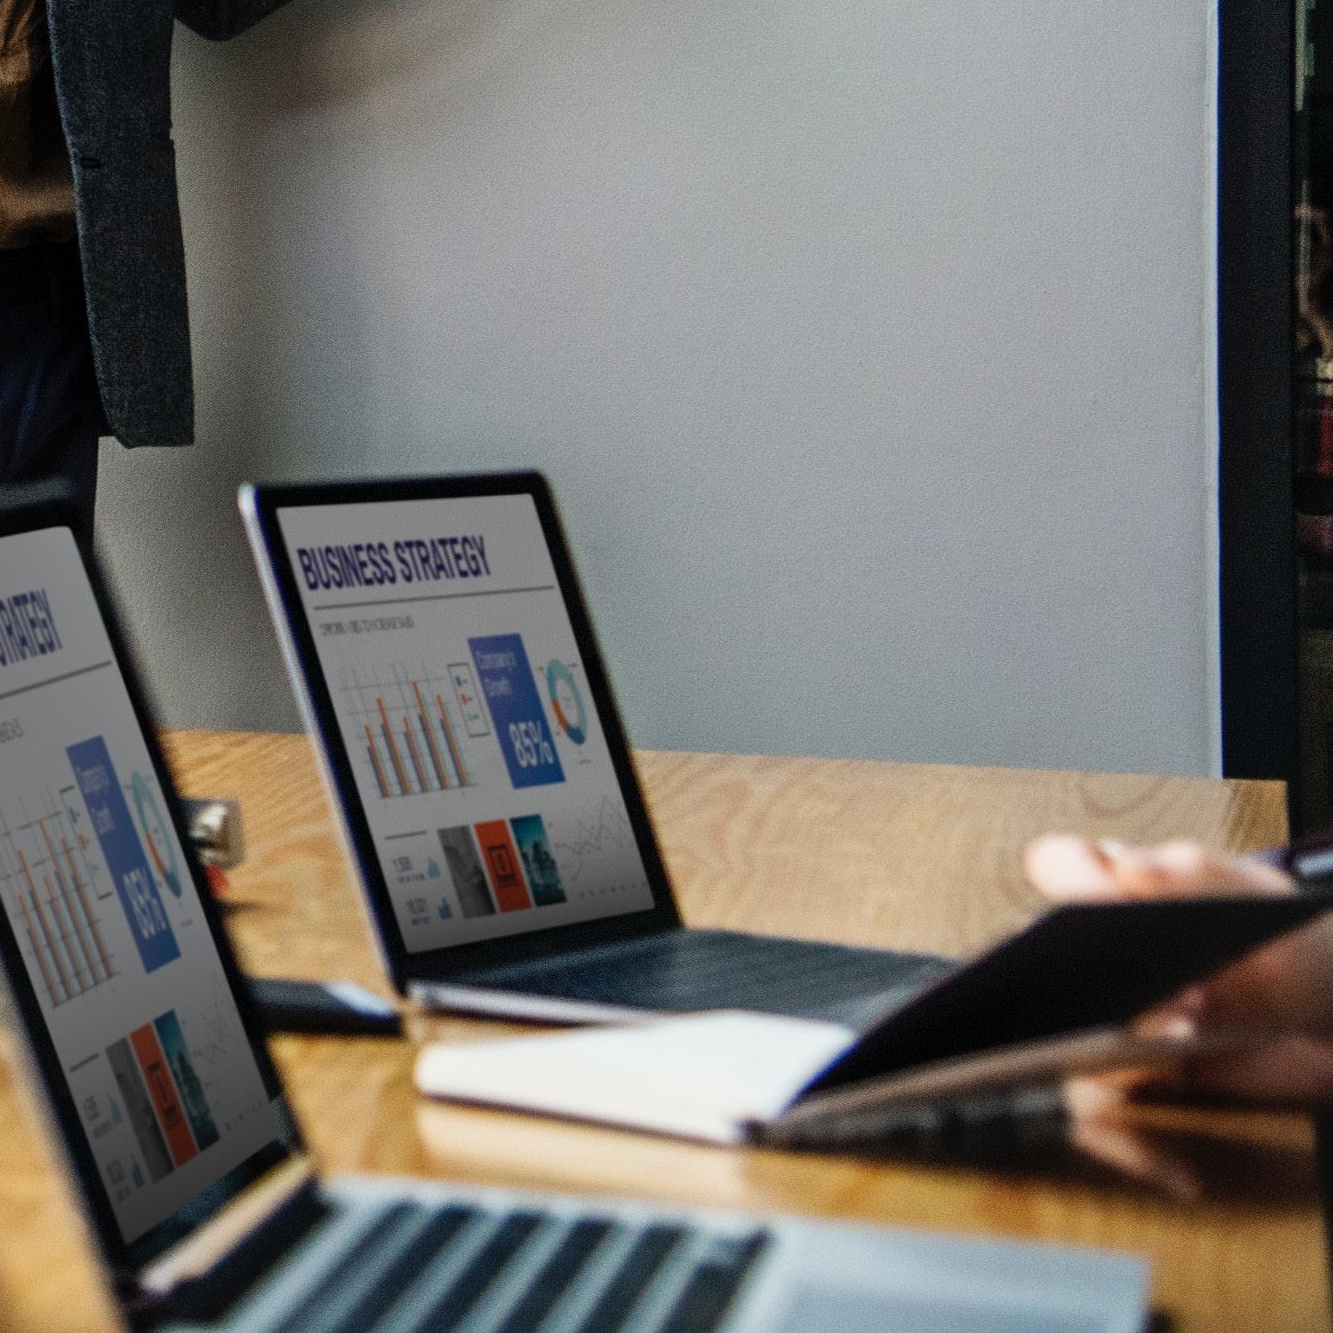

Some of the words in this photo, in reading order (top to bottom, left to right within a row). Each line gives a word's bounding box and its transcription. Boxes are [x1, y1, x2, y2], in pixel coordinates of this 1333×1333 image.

[297, 542, 396, 590] BUSINESS
[393, 535, 491, 582] STRATEGY
[509, 720, 553, 767] 85%
